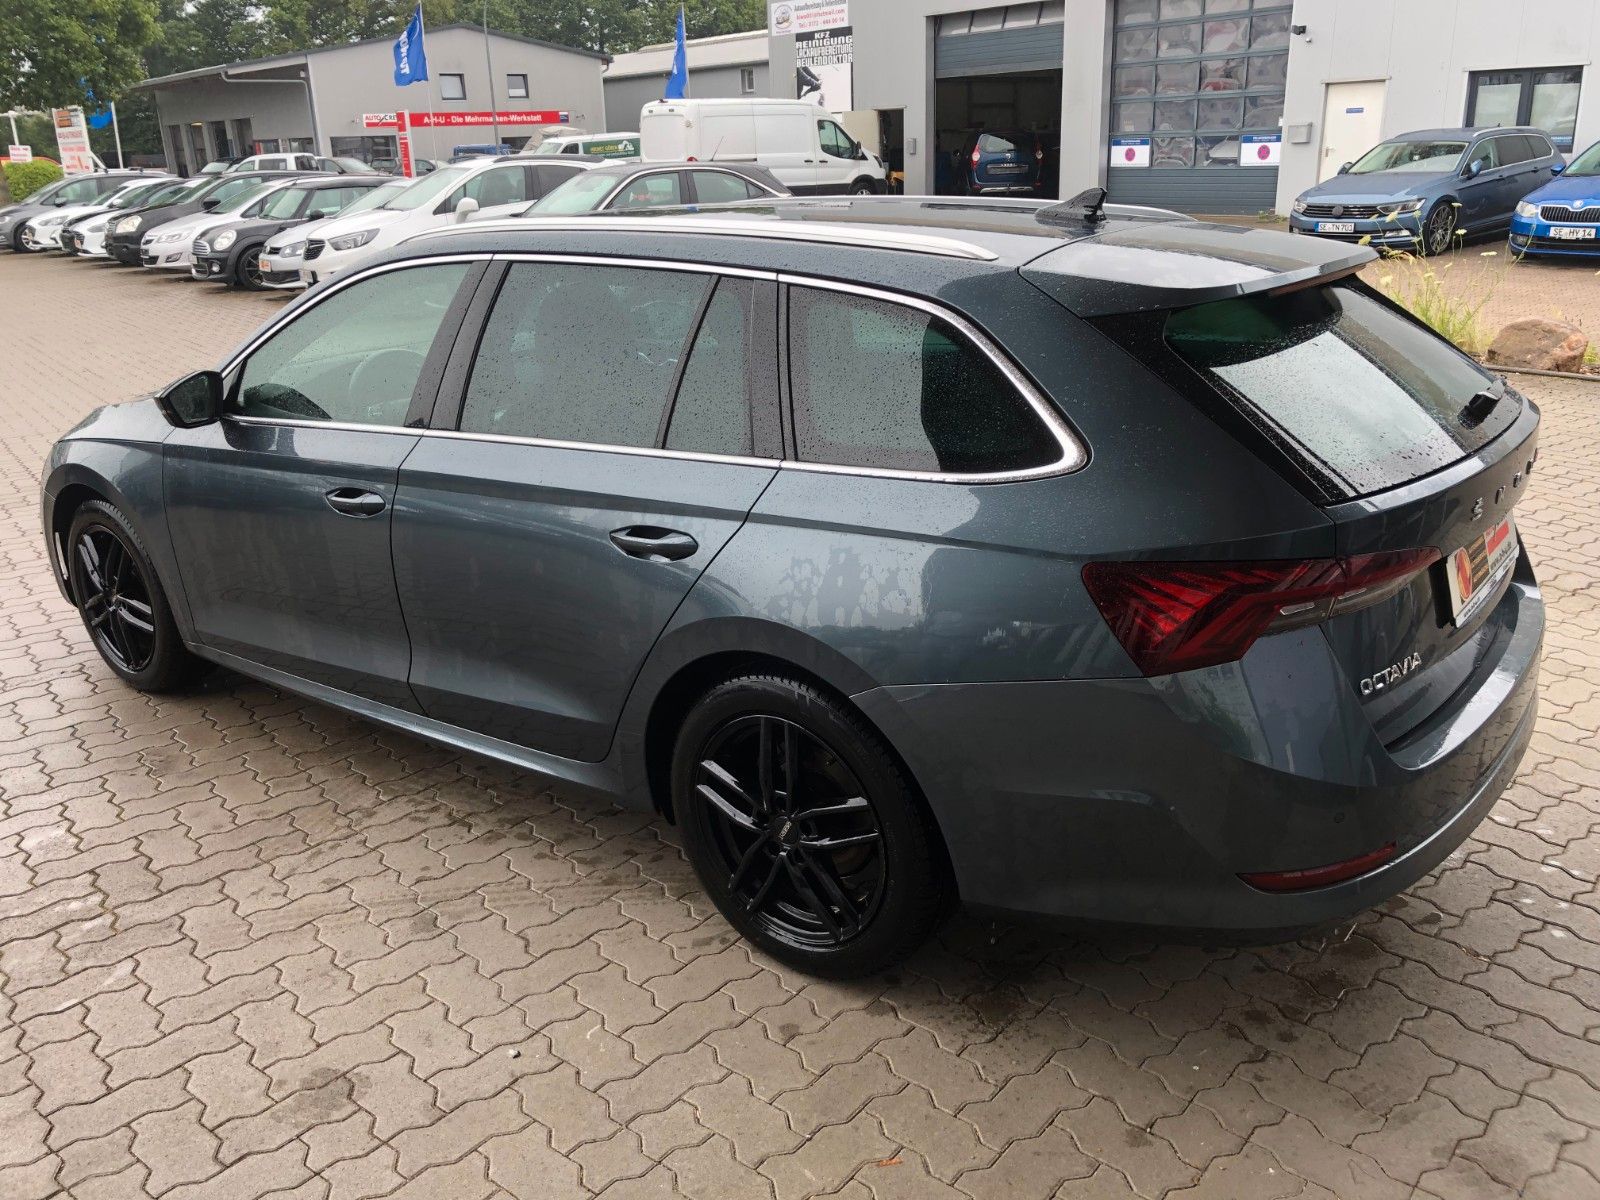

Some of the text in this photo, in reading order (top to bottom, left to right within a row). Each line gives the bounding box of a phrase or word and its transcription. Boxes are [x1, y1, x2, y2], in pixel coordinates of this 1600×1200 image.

[814, 31, 830, 39] KFZ
[796, 35, 852, 48] REINIGUNG
[796, 53, 853, 68] BEULENDOKTOR
[464, 114, 542, 122] Mehrmaken-Werkstatt
[1320, 223, 1328, 231] SE
[1332, 223, 1341, 231] TN
[1553, 227, 1563, 236] SE
[1582, 228, 1592, 237] 14
[1360, 652, 1422, 696] OCTAVIA
